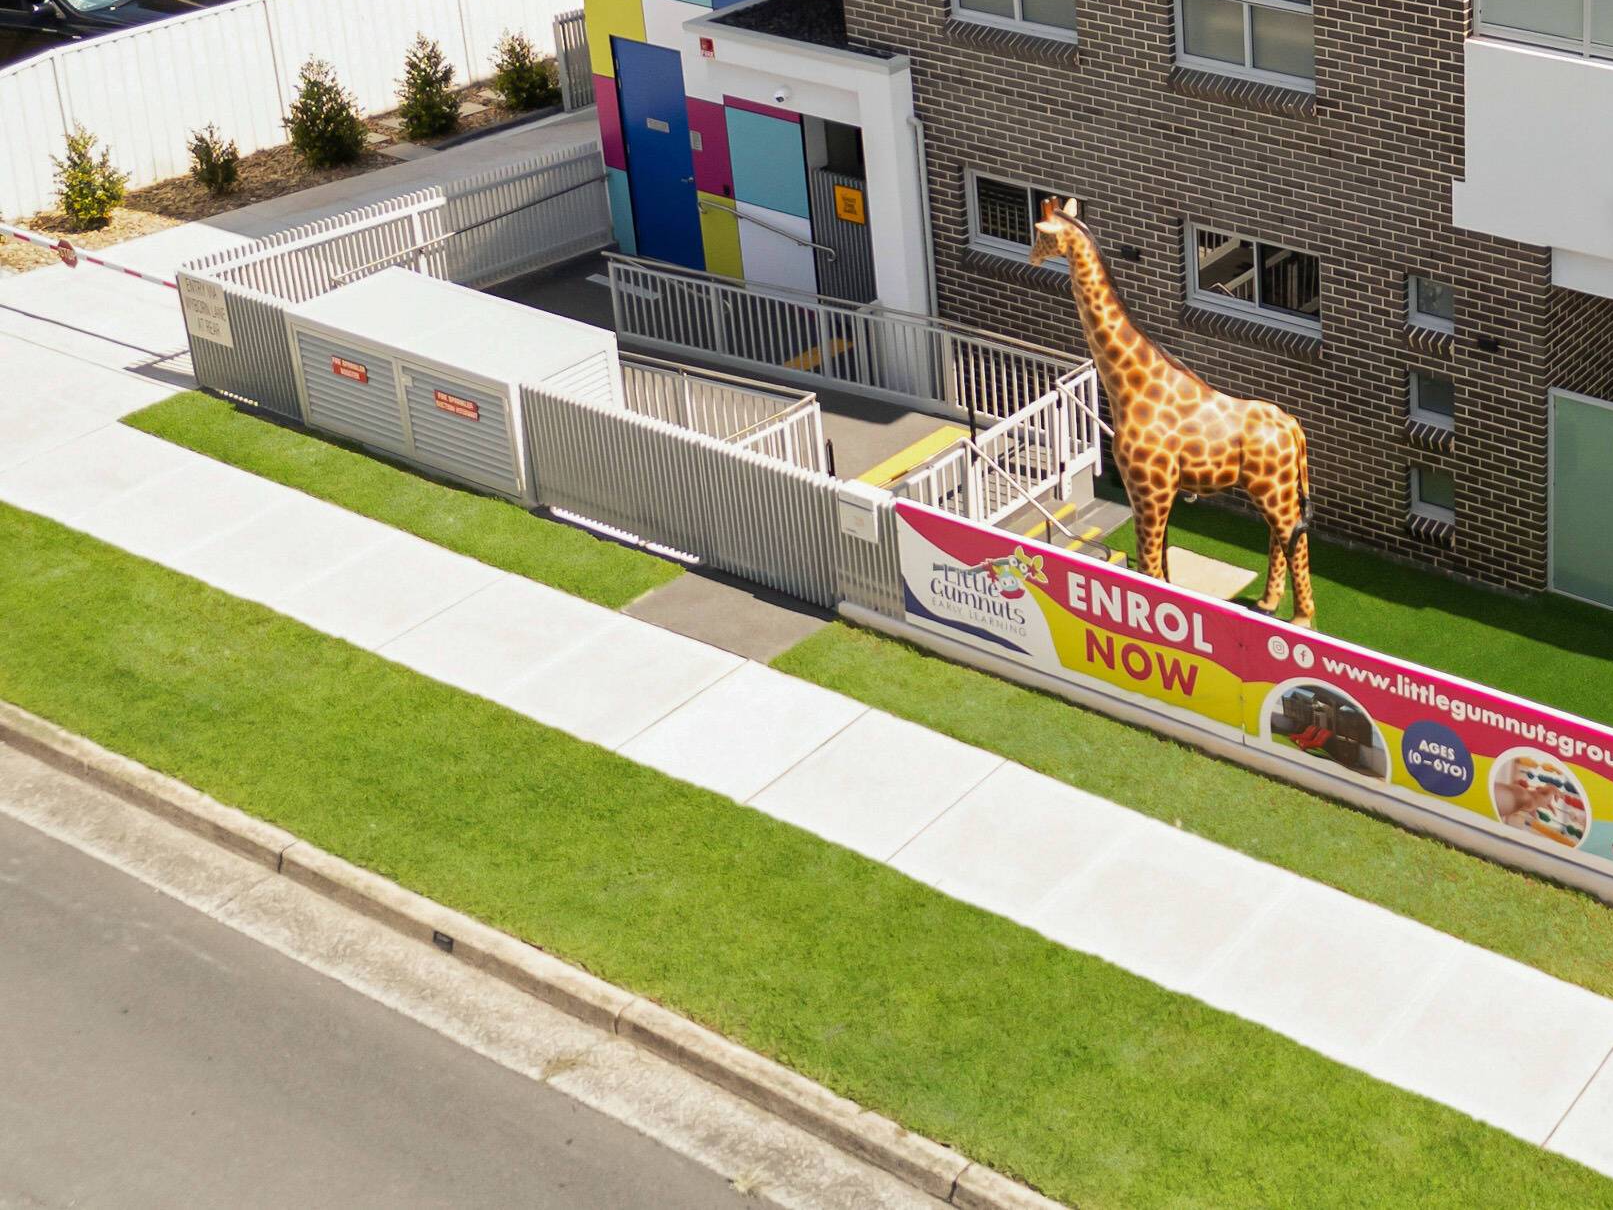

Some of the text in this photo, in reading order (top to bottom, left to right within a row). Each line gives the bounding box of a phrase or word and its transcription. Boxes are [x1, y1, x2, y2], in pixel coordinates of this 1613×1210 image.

[930, 577, 1026, 625] Gumnuts
[944, 564, 999, 597] Little
[931, 596, 1027, 637] EARLY LEARNING
[1067, 571, 1213, 654] ENROL
[1085, 628, 1199, 697] NOW
[1418, 739, 1456, 761] AGES
